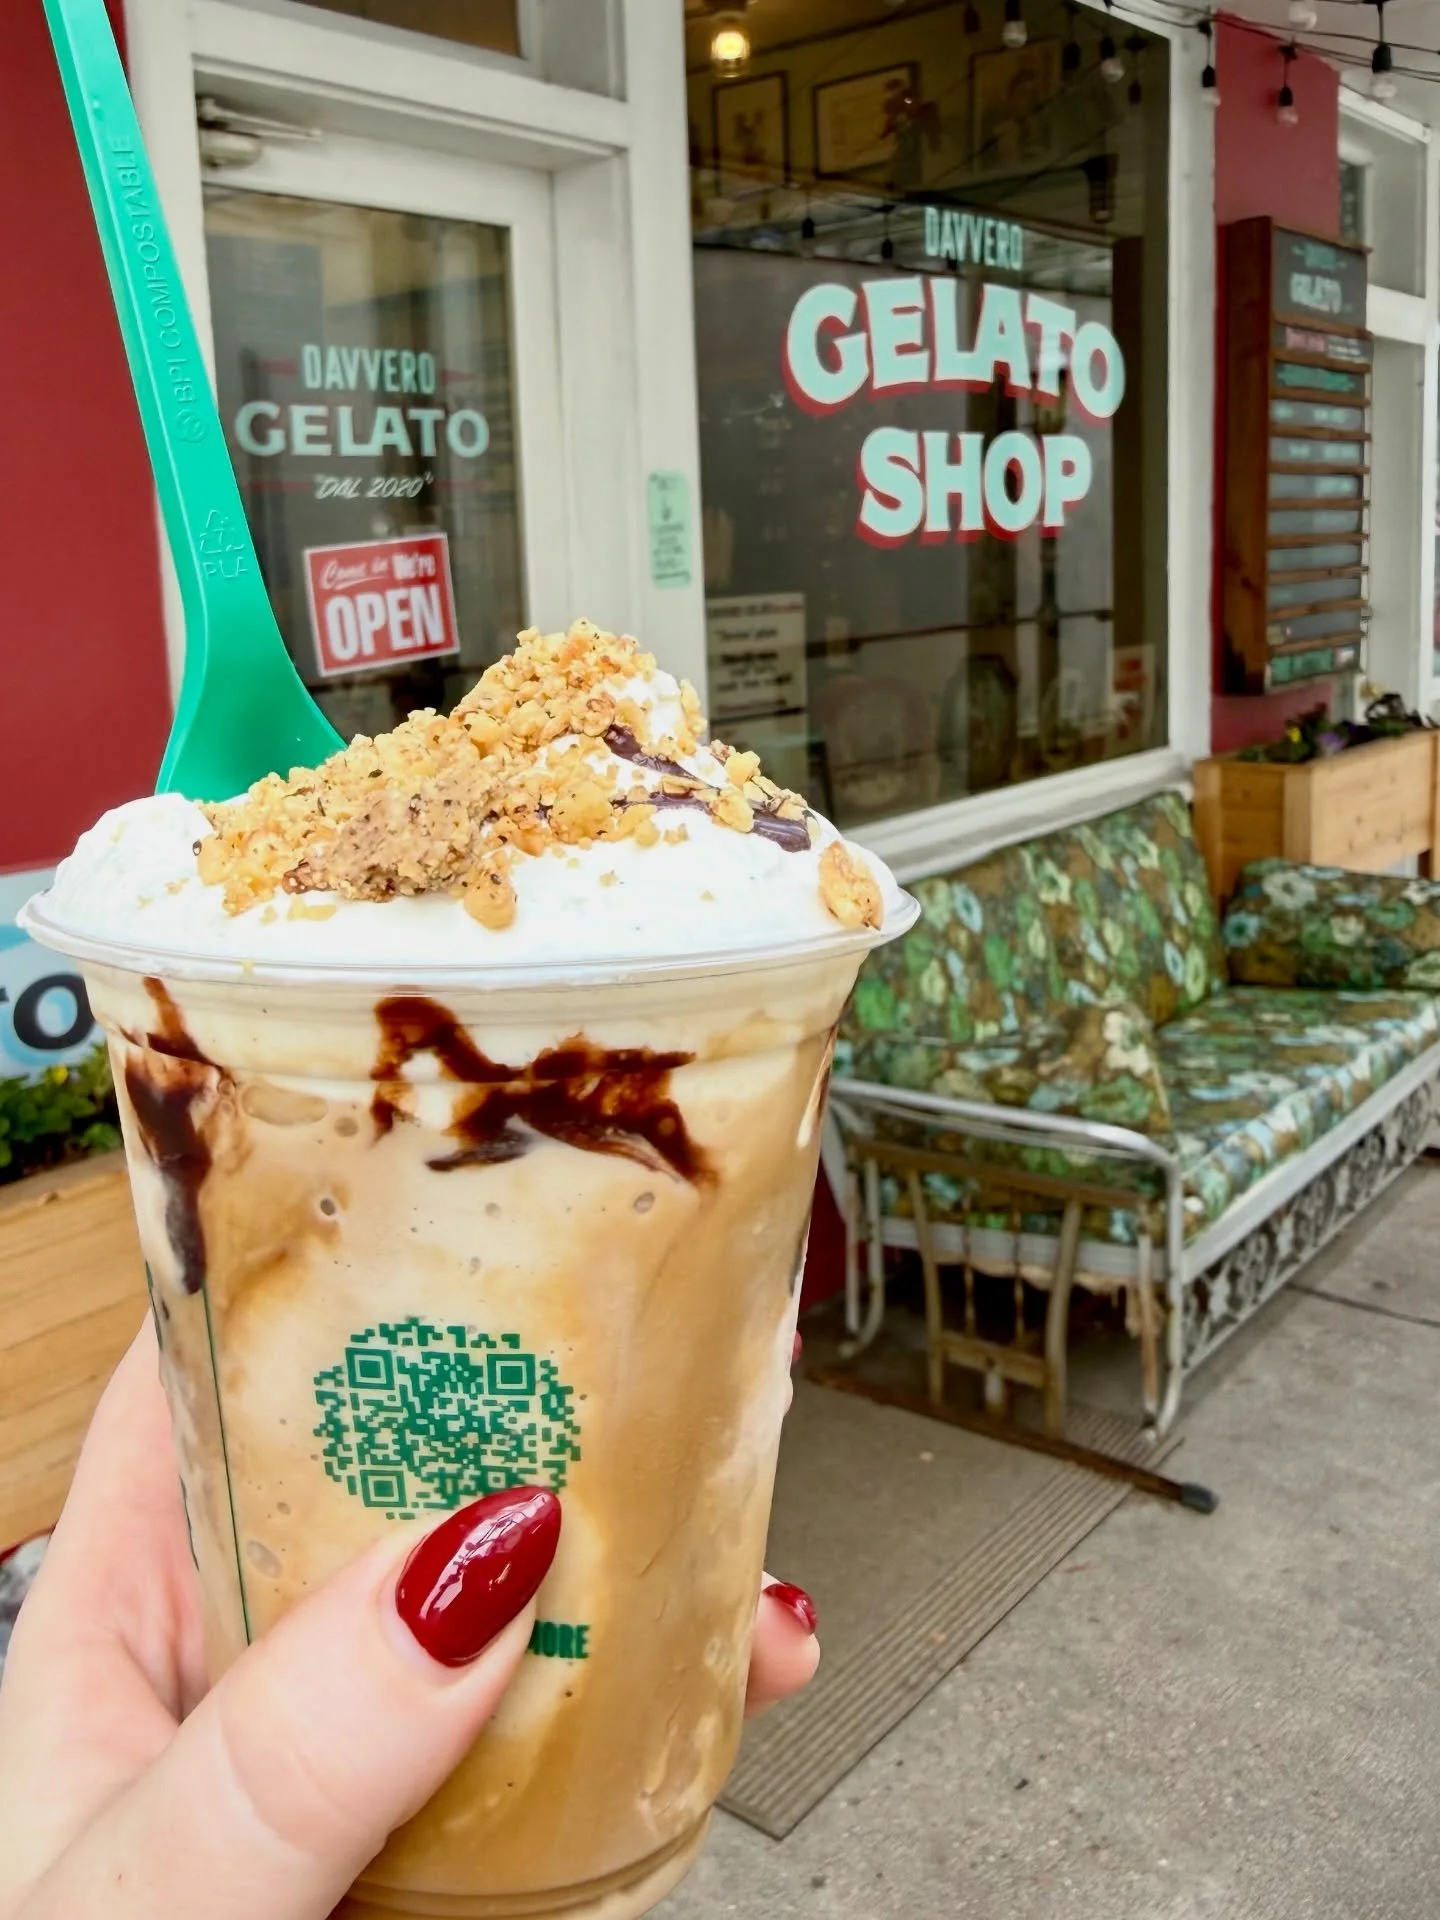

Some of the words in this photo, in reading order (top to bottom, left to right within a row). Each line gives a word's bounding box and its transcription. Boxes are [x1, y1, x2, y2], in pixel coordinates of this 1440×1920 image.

[110, 134, 182, 348] COMPOSTABLE
[923, 205, 1024, 272] DAVVERO
[302, 343, 436, 395] DAVVERO
[784, 276, 1126, 424] GELATO
[234, 400, 490, 458] GELATO
[857, 426, 1092, 546] SHOP
[324, 583, 447, 661] OPEN
